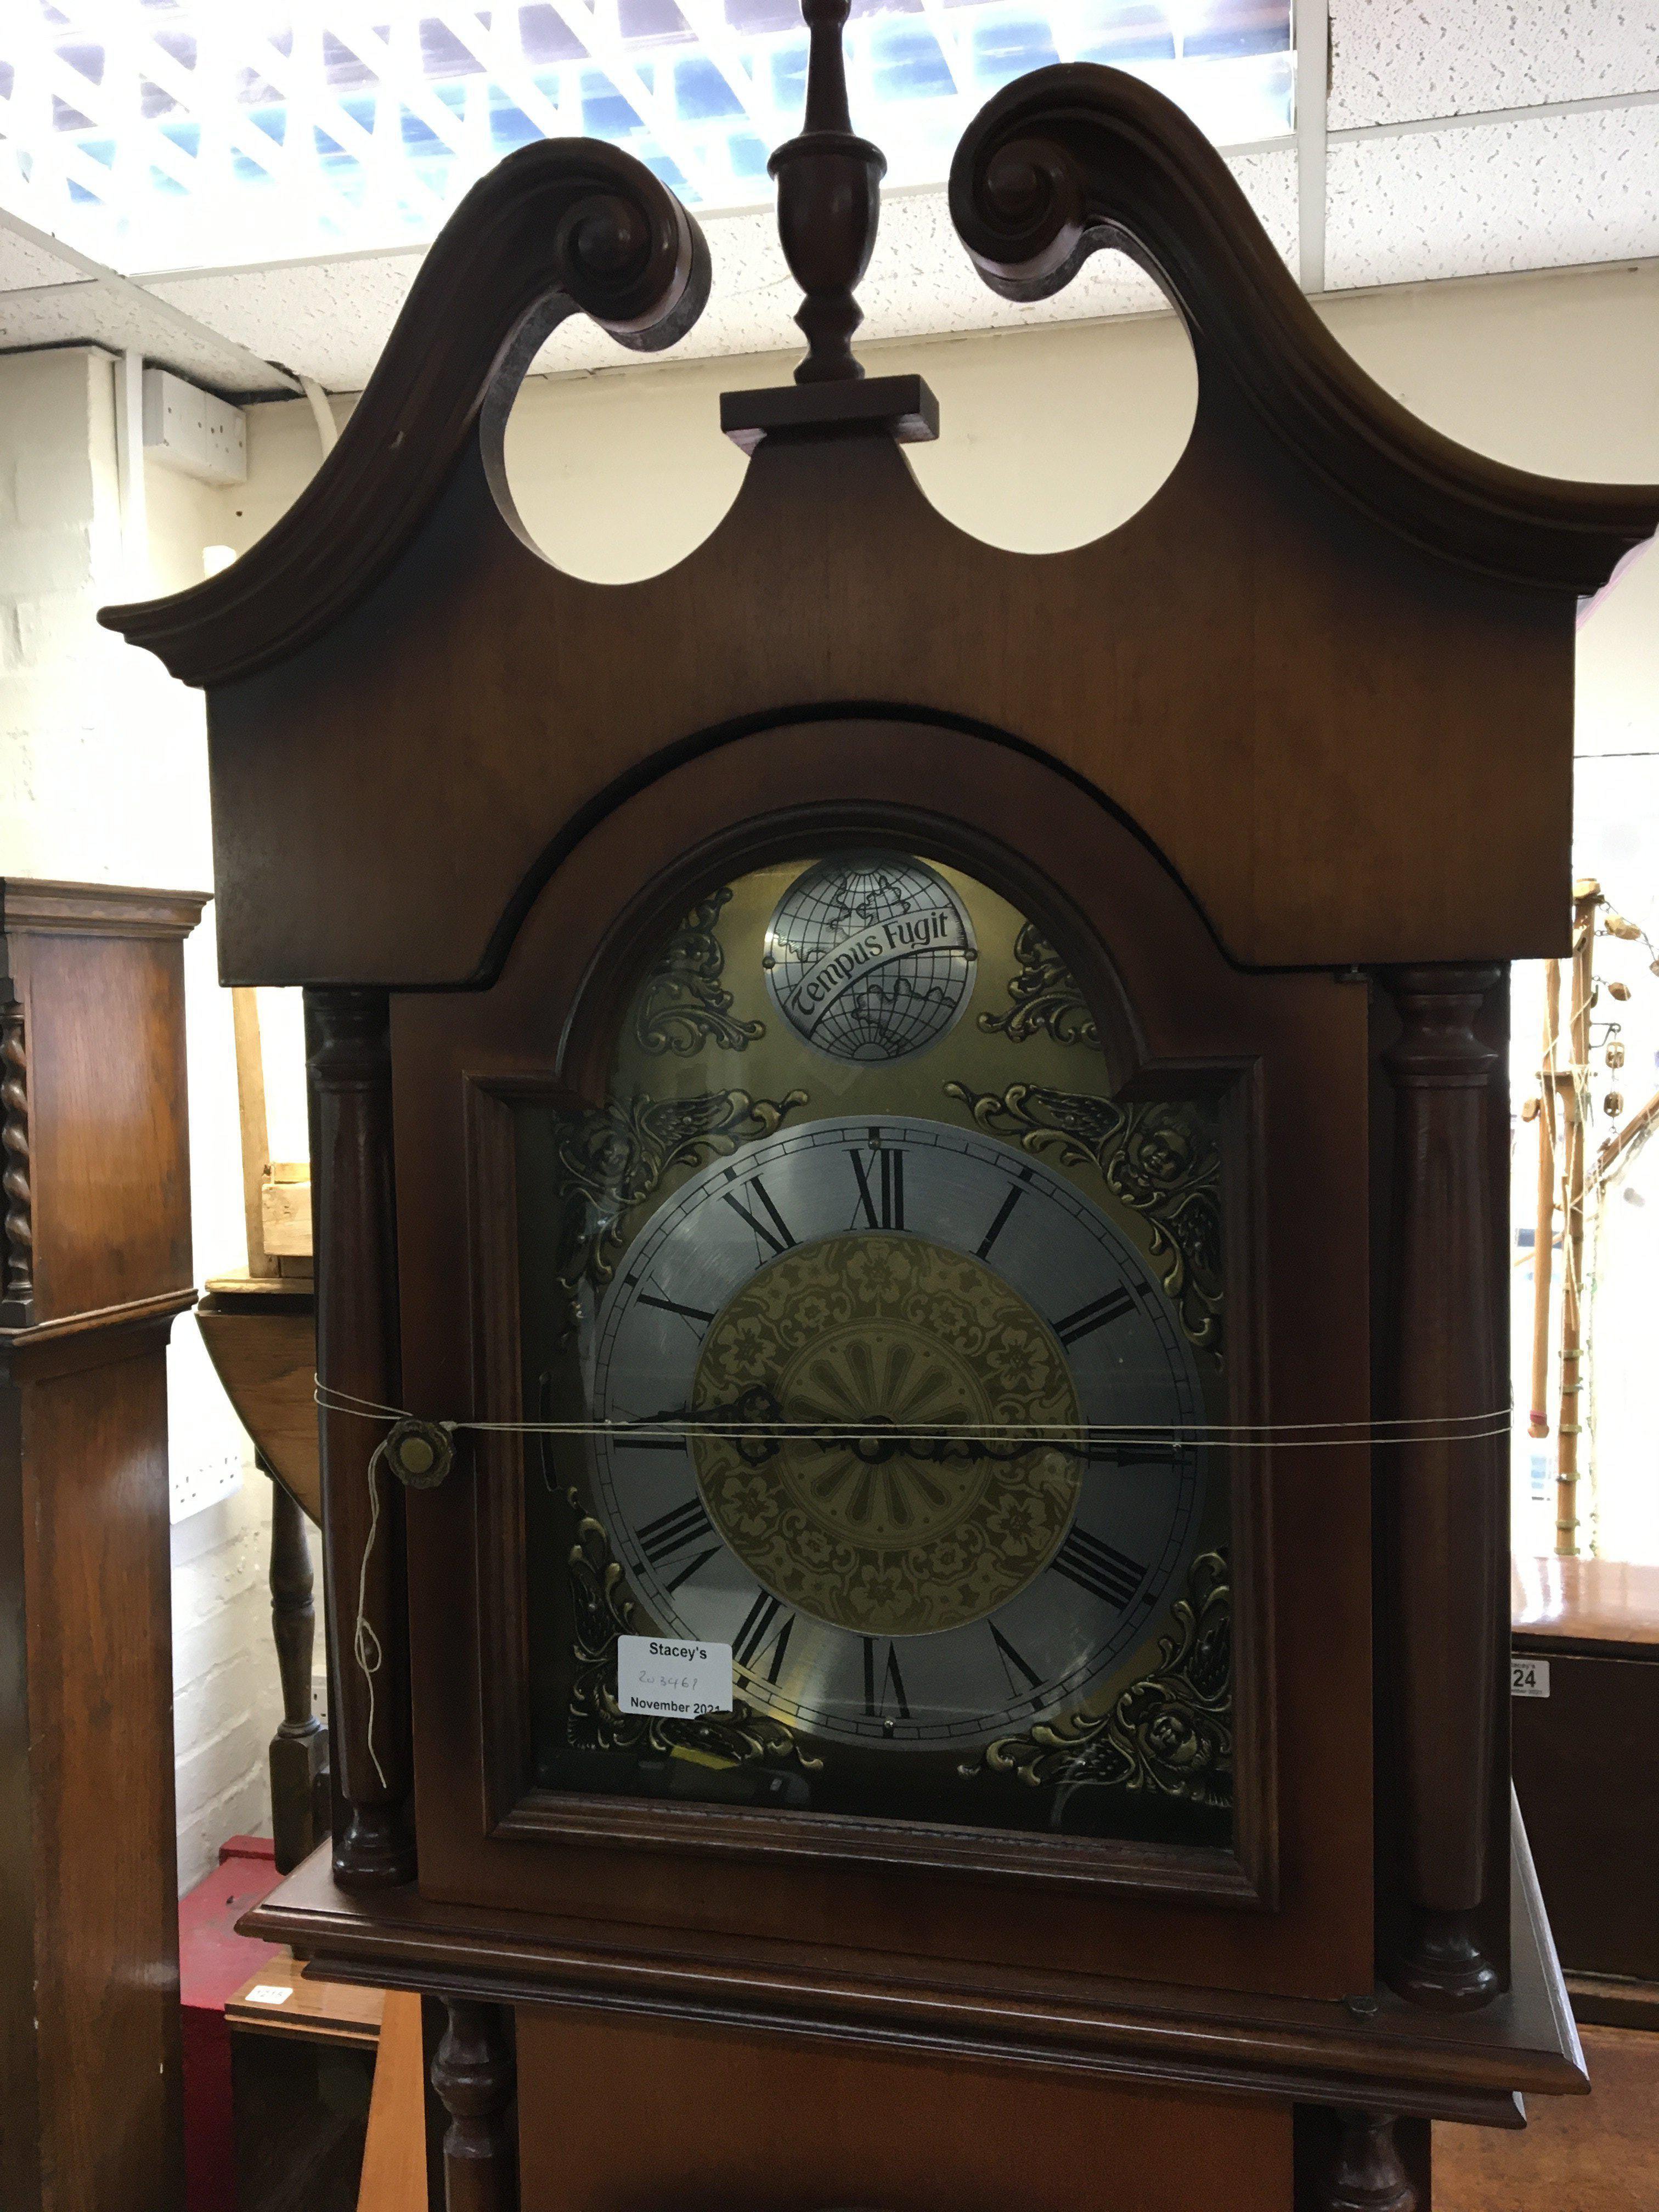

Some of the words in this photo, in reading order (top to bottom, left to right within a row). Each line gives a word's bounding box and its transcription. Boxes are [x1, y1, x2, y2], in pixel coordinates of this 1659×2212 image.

[791, 935, 883, 1016] Tempus
[882, 911, 949, 951] Fugit
[842, 1148, 915, 1232] XII
[716, 1172, 804, 1271] XI
[650, 1642, 707, 1661] Stacey's
[1513, 1669, 1536, 1688] 24
[630, 1697, 690, 1713] November
